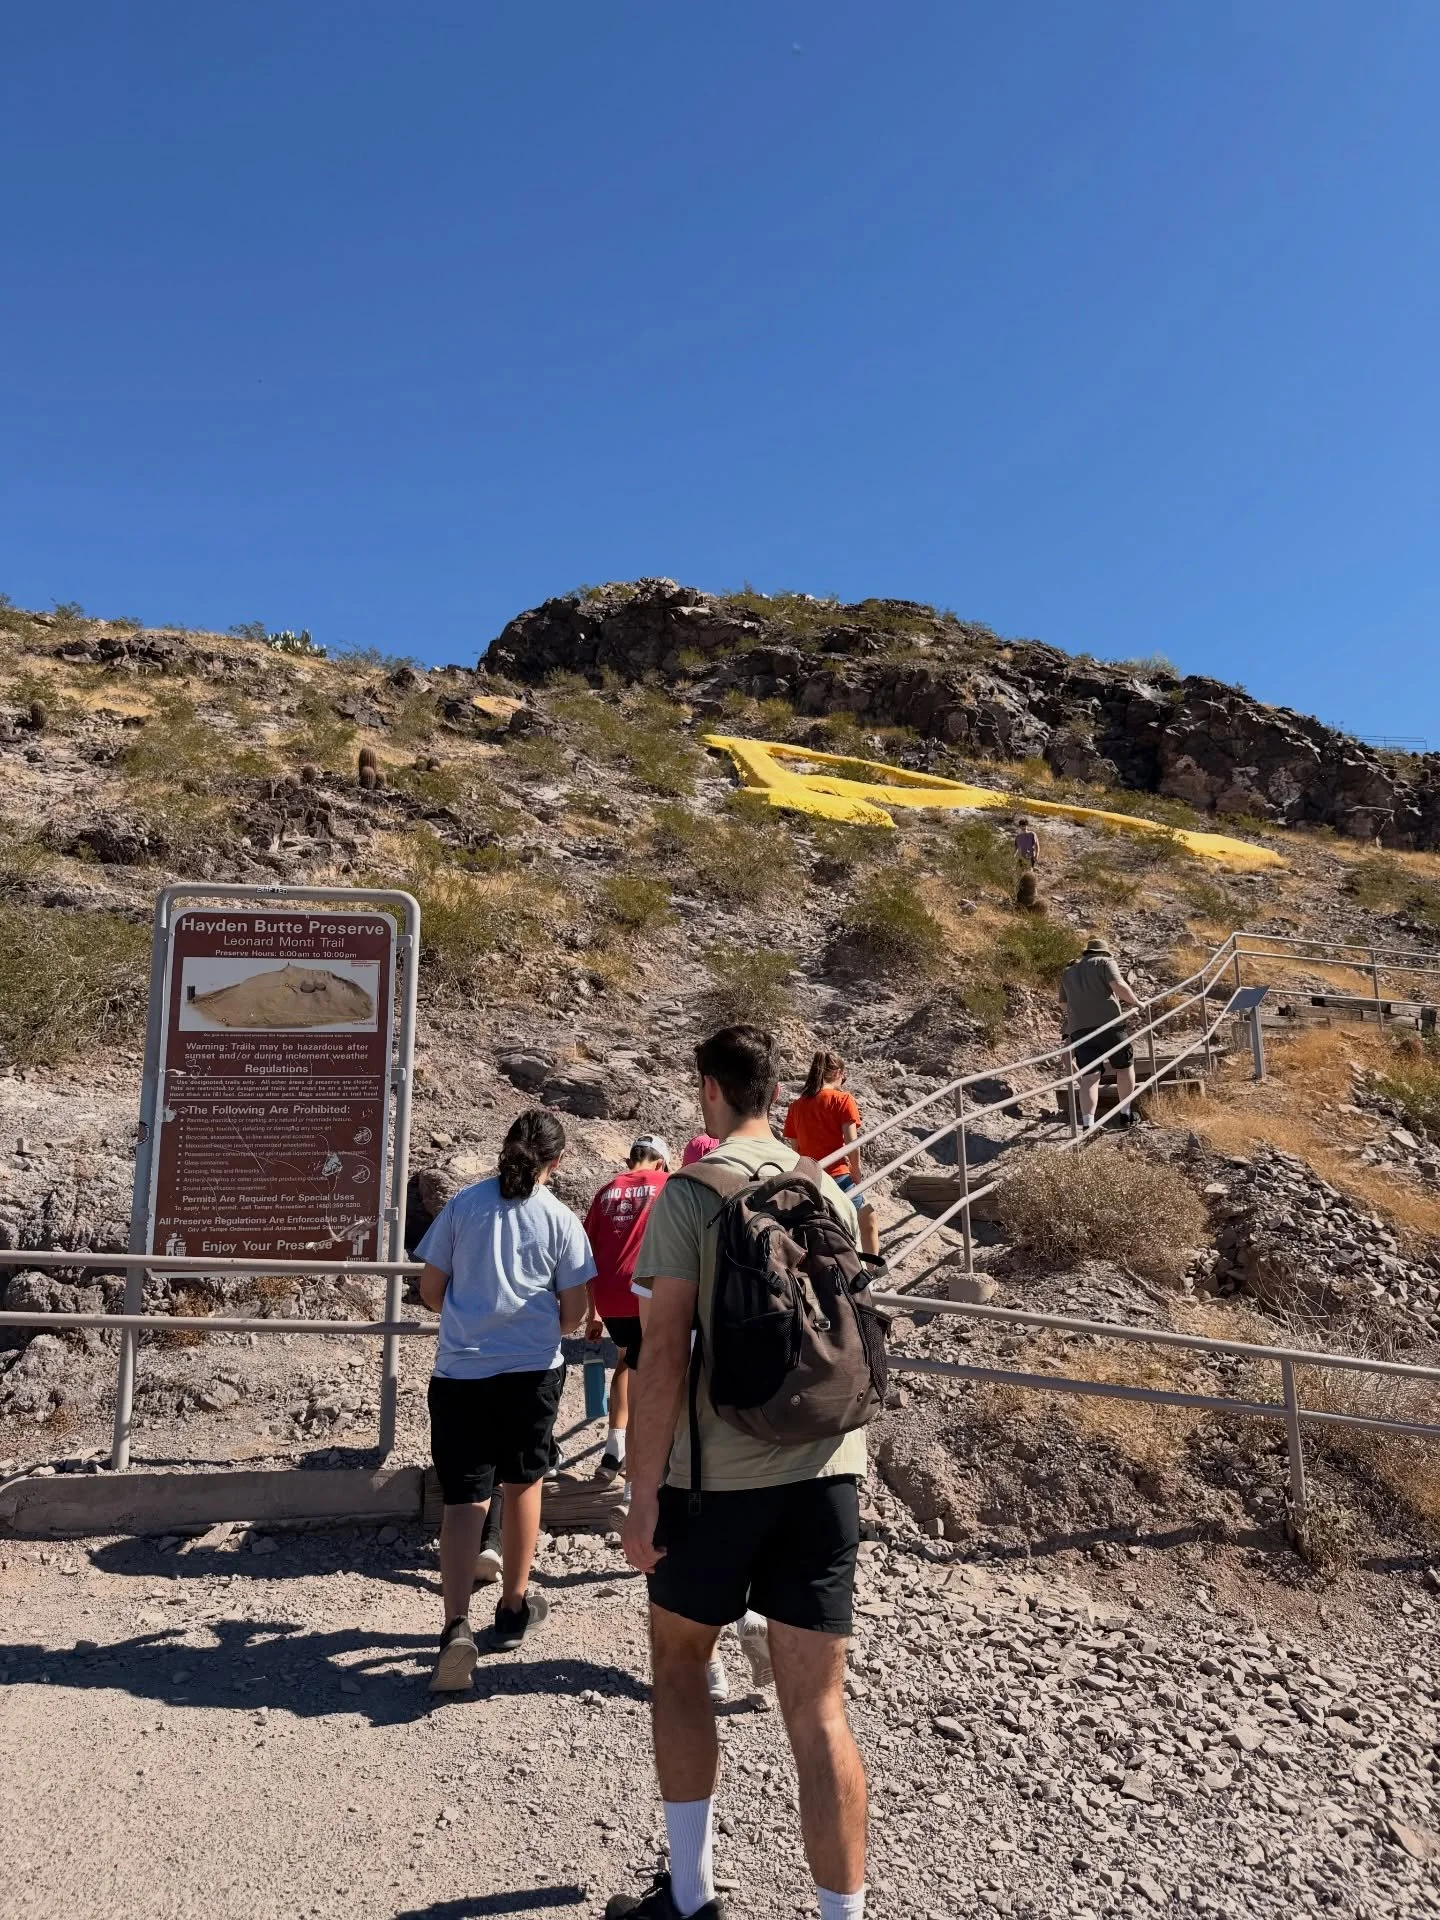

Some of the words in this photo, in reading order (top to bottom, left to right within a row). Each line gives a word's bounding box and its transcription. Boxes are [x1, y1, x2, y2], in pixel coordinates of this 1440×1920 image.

[181, 917, 248, 935] Hayden
[254, 919, 303, 934] Butte
[308, 920, 384, 935] Preserve
[223, 935, 274, 946] Leonard
[279, 936, 314, 947] Monti
[319, 937, 345, 948] Trail
[215, 949, 249, 957] Preserve
[186, 1042, 228, 1051] Warning:
[231, 1042, 256, 1050] Trails
[259, 1043, 279, 1051] may
[218, 1051, 251, 1060] and/or
[254, 1052, 283, 1060] during
[245, 1064, 309, 1074] Regulations
[187, 1105, 208, 1114] The
[212, 1105, 265, 1116] Following
[269, 1105, 289, 1114] Are
[293, 1104, 350, 1114] Prohibited:
[624, 1185, 657, 1198] STATE
[182, 1194, 217, 1203] Permits
[219, 1194, 236, 1203] Are
[238, 1194, 278, 1203] Required
[280, 1194, 295, 1202] For
[298, 1193, 330, 1203] Special
[333, 1193, 355, 1201] Uses
[158, 1217, 171, 1225] All
[173, 1217, 212, 1225] Preserve
[214, 1216, 267, 1226] Regulations
[269, 1216, 285, 1224] Are
[287, 1215, 338, 1224] Enforceable
[340, 1214, 352, 1224] By
[354, 1213, 376, 1222] Law:
[202, 1240, 238, 1254] Enjoy
[242, 1240, 272, 1251] Your
